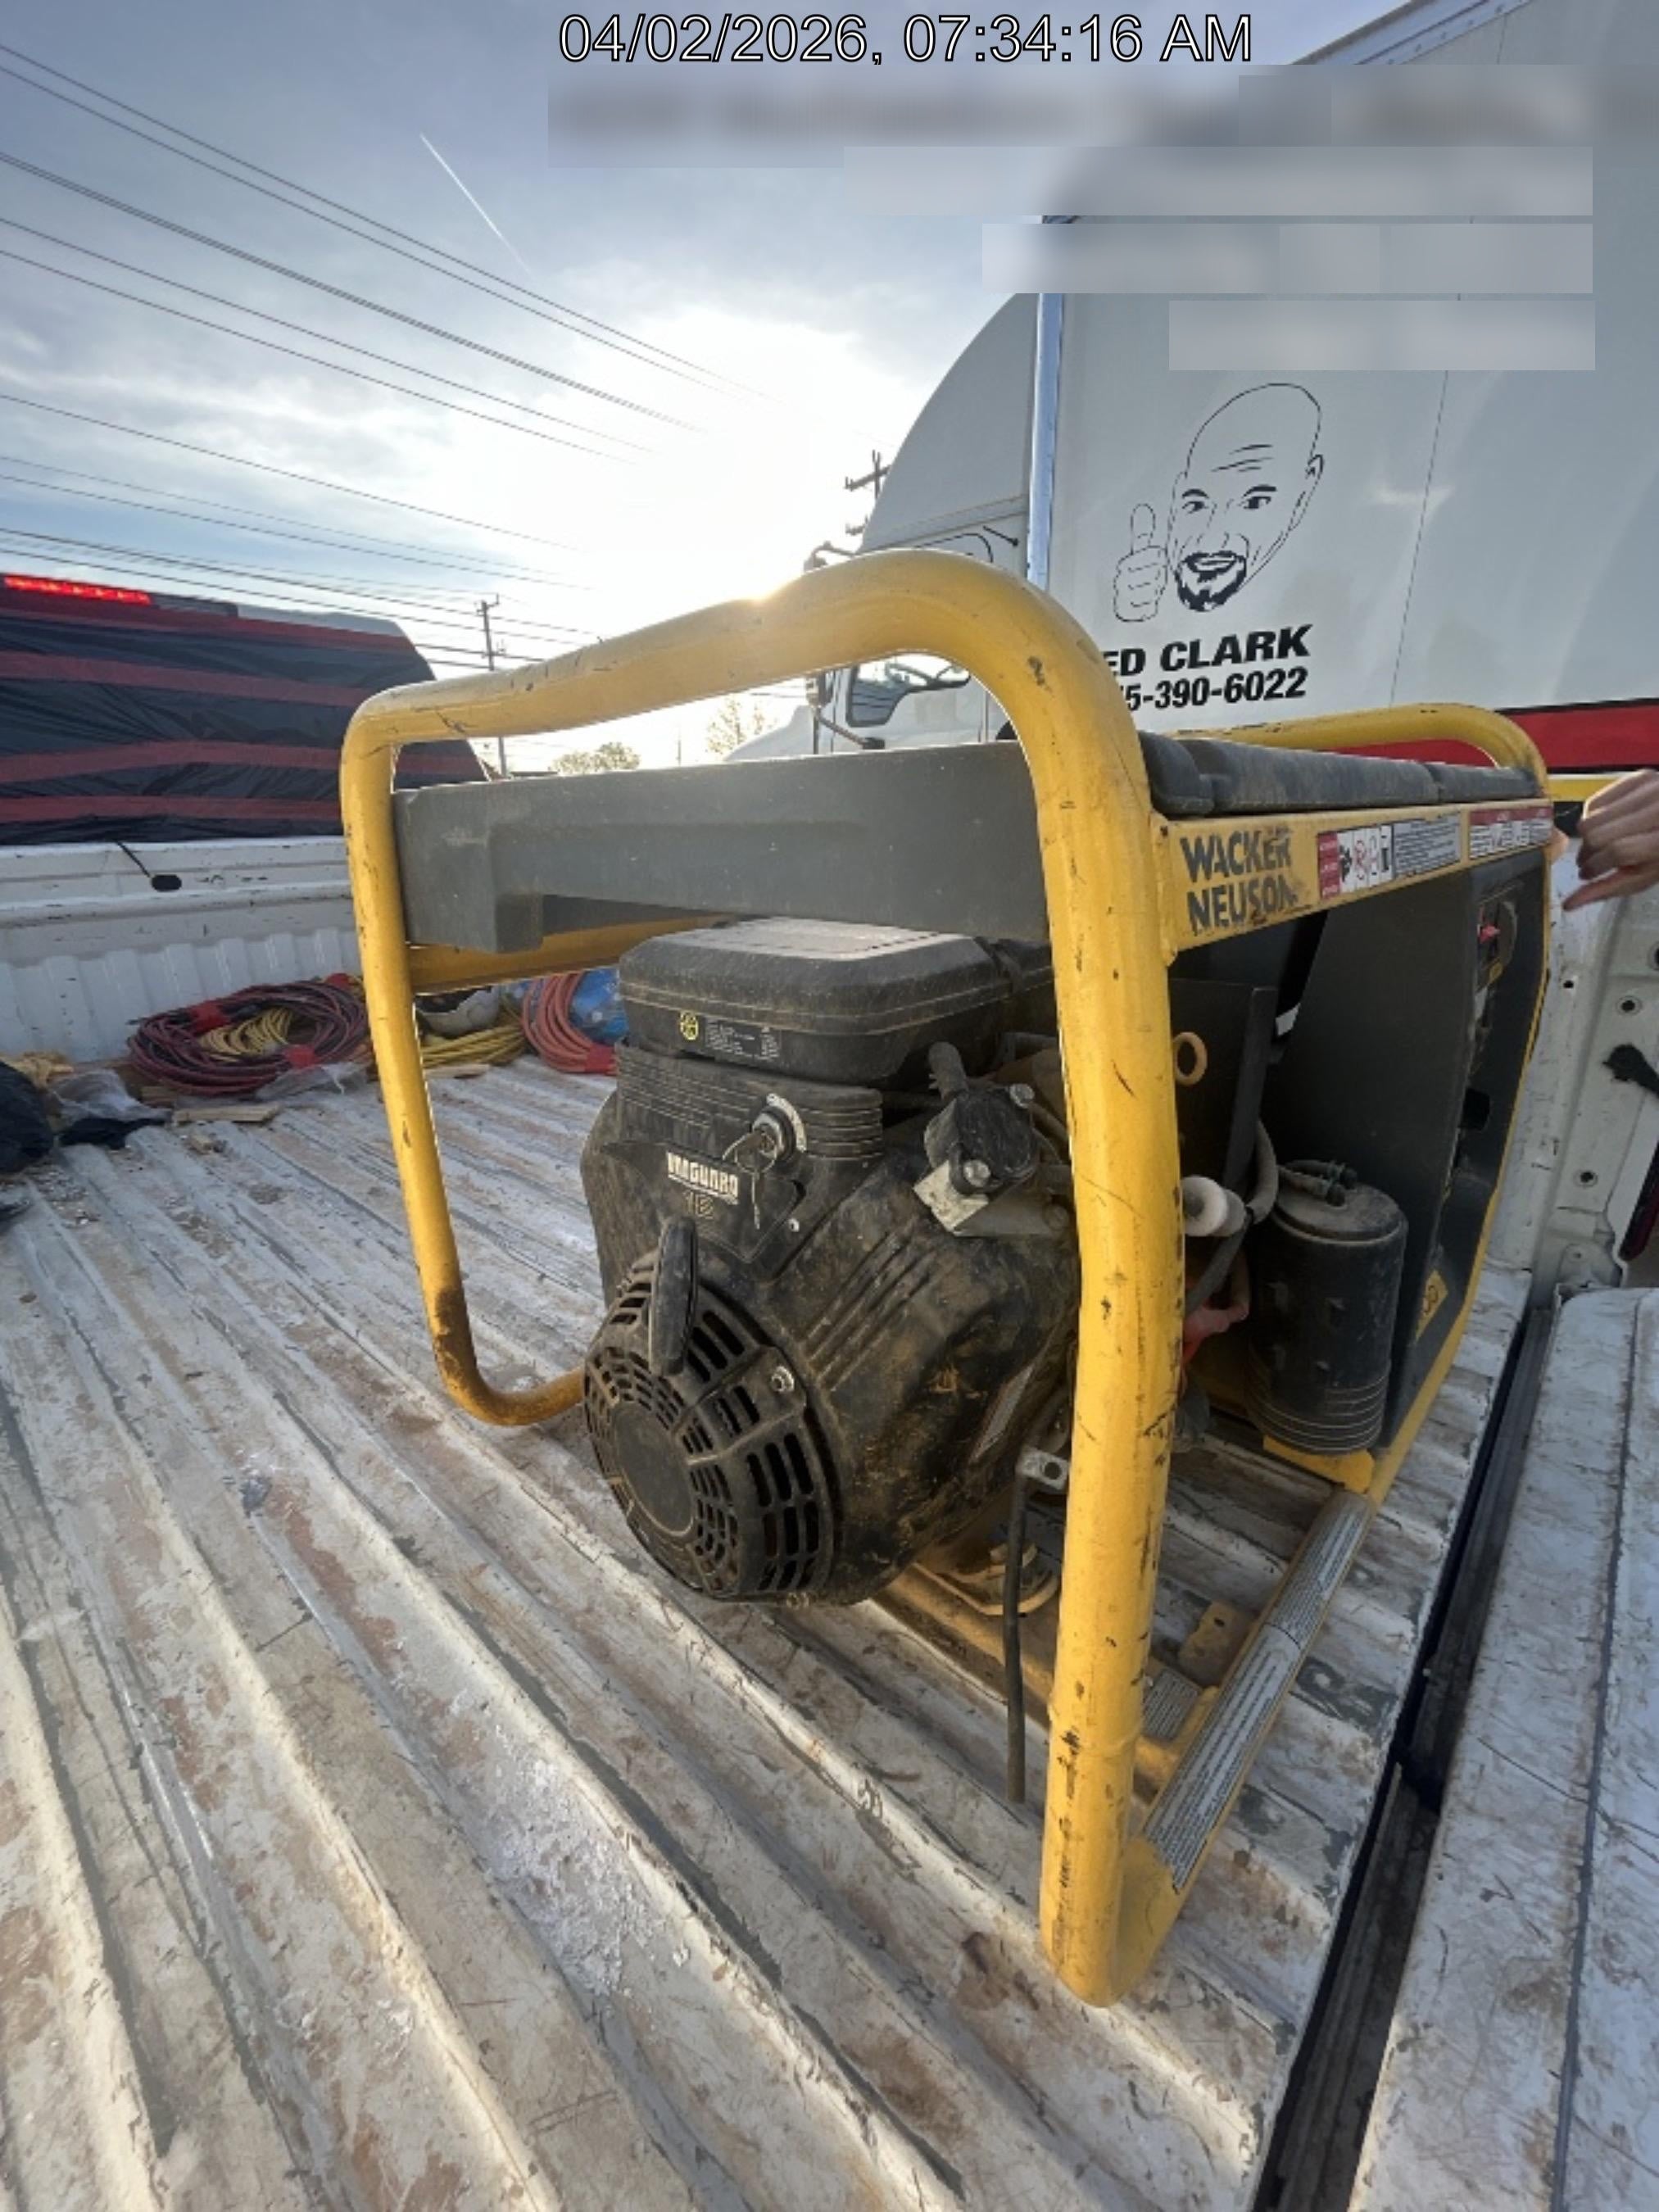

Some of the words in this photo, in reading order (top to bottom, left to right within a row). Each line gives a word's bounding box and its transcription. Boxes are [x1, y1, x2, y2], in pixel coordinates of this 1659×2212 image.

[1160, 623, 1313, 672] CLARK
[1120, 665, 1308, 711] 5-390-6022
[1180, 828, 1292, 883] WACKER
[1187, 874, 1298, 936] NEUSON
